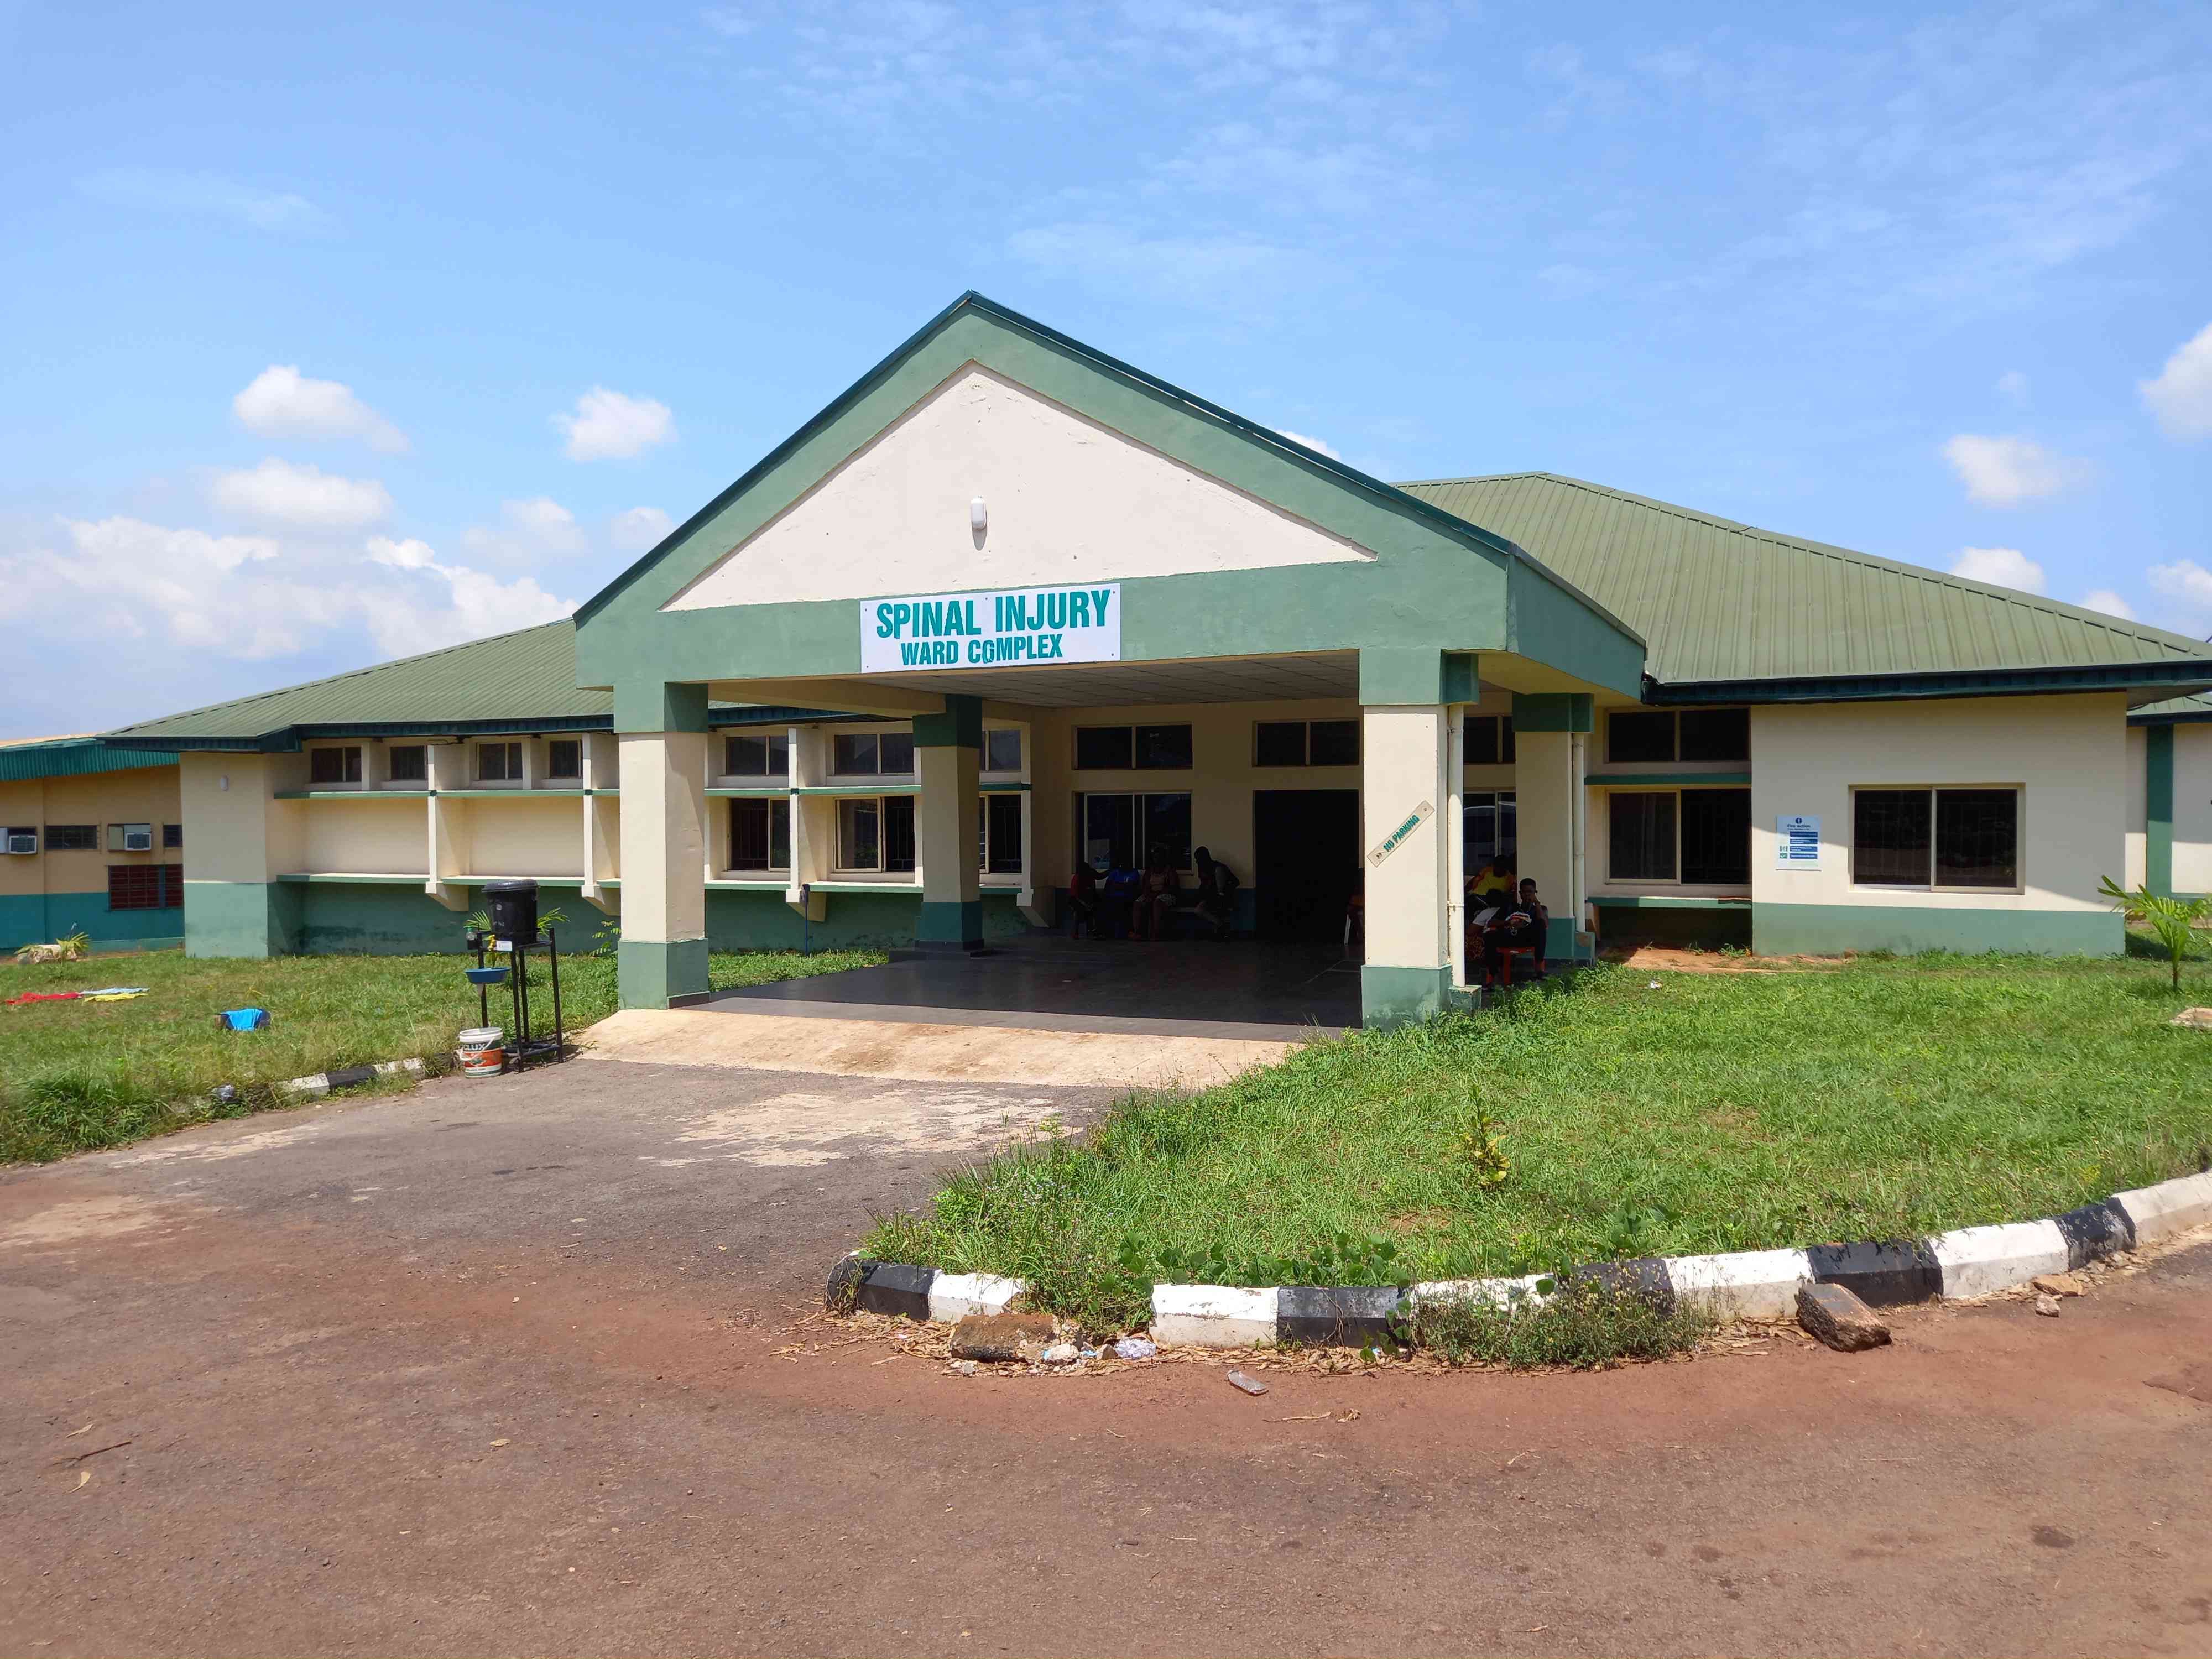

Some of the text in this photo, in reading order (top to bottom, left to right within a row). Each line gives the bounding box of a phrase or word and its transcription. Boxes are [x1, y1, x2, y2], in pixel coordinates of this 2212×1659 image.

[877, 589, 1111, 639] SPINAL INJURY
[901, 634, 1063, 666] WARD COMPLEX
[1383, 815, 1420, 852] NO PARKING
